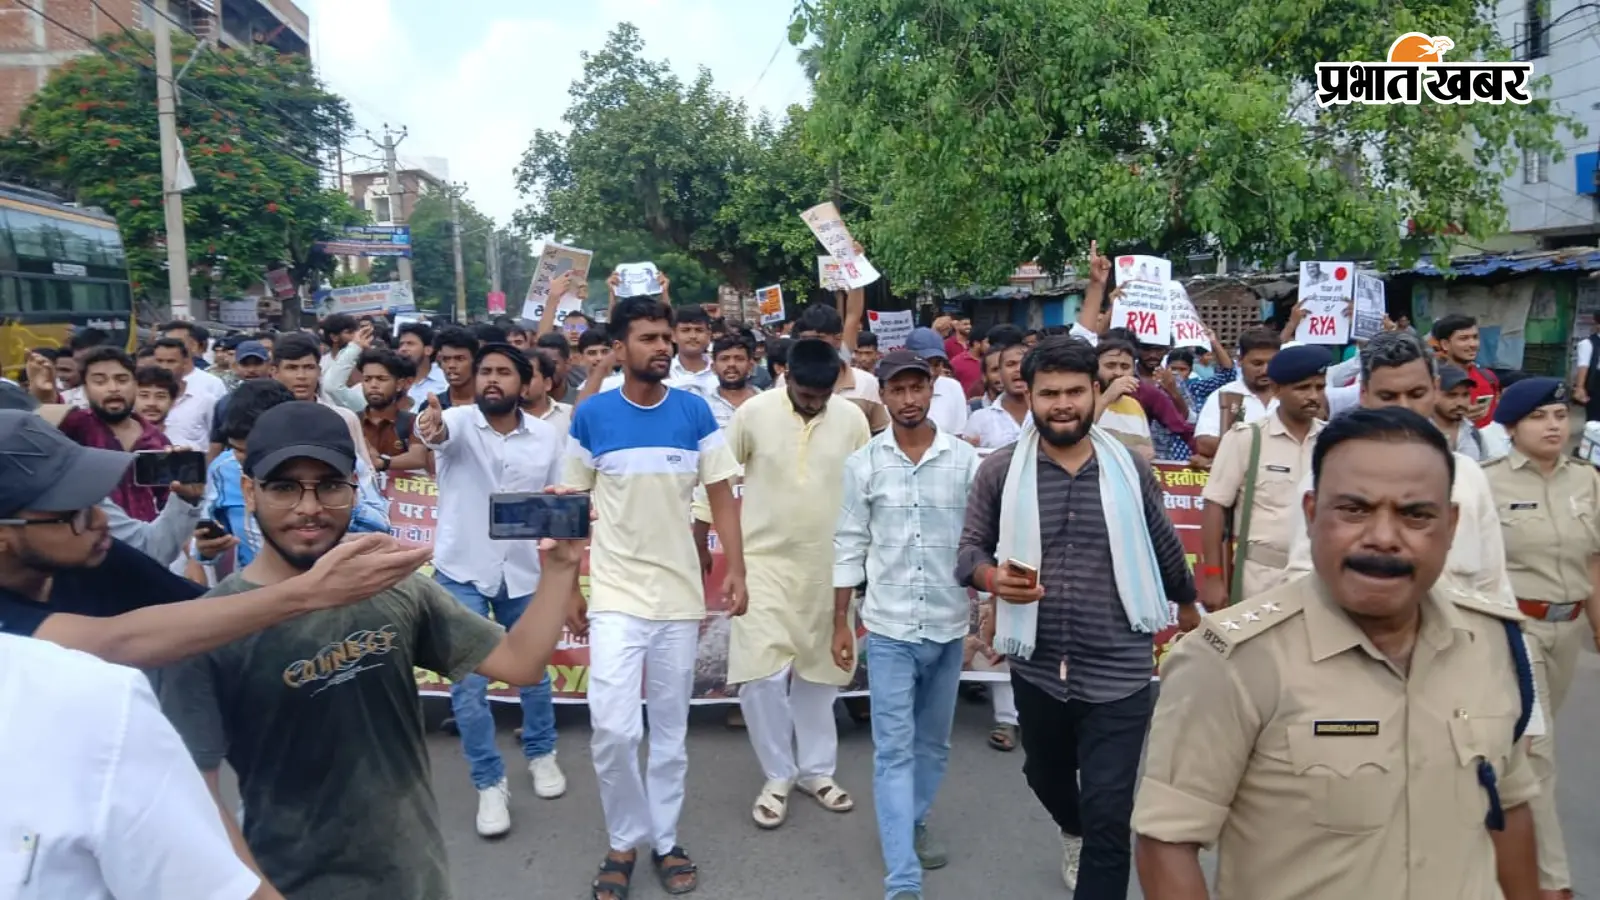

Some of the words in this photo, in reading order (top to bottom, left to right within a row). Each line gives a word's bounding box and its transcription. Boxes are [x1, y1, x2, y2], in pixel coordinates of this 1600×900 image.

[1126, 311, 1158, 335] RYA
[1309, 315, 1336, 336] RYA
[398, 502, 426, 519] पर
